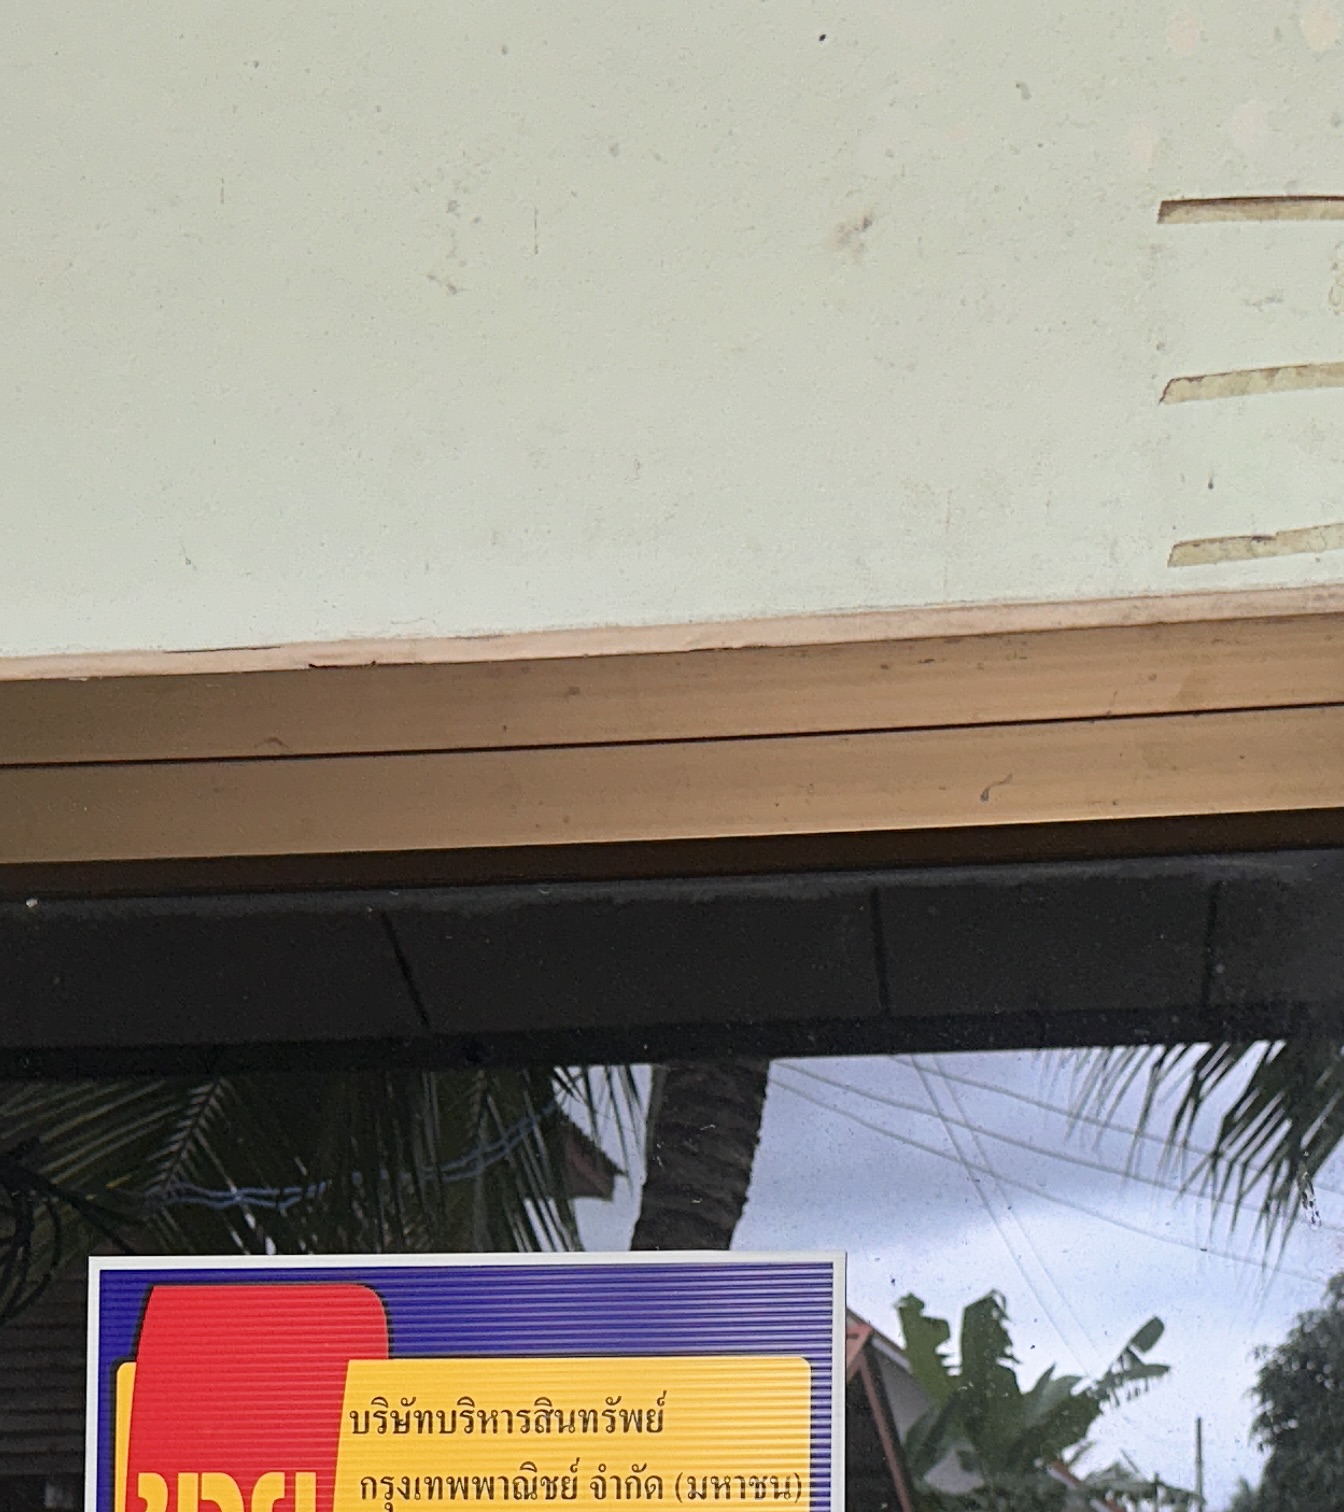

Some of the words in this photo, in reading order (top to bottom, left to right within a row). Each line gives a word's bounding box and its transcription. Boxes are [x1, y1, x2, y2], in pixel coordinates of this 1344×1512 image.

[349, 1390, 667, 1435] บริษัทบริหารสินทรัพย์
[589, 1463, 664, 1501] จำกัด
[674, 1471, 803, 1505] (มหาชน)
